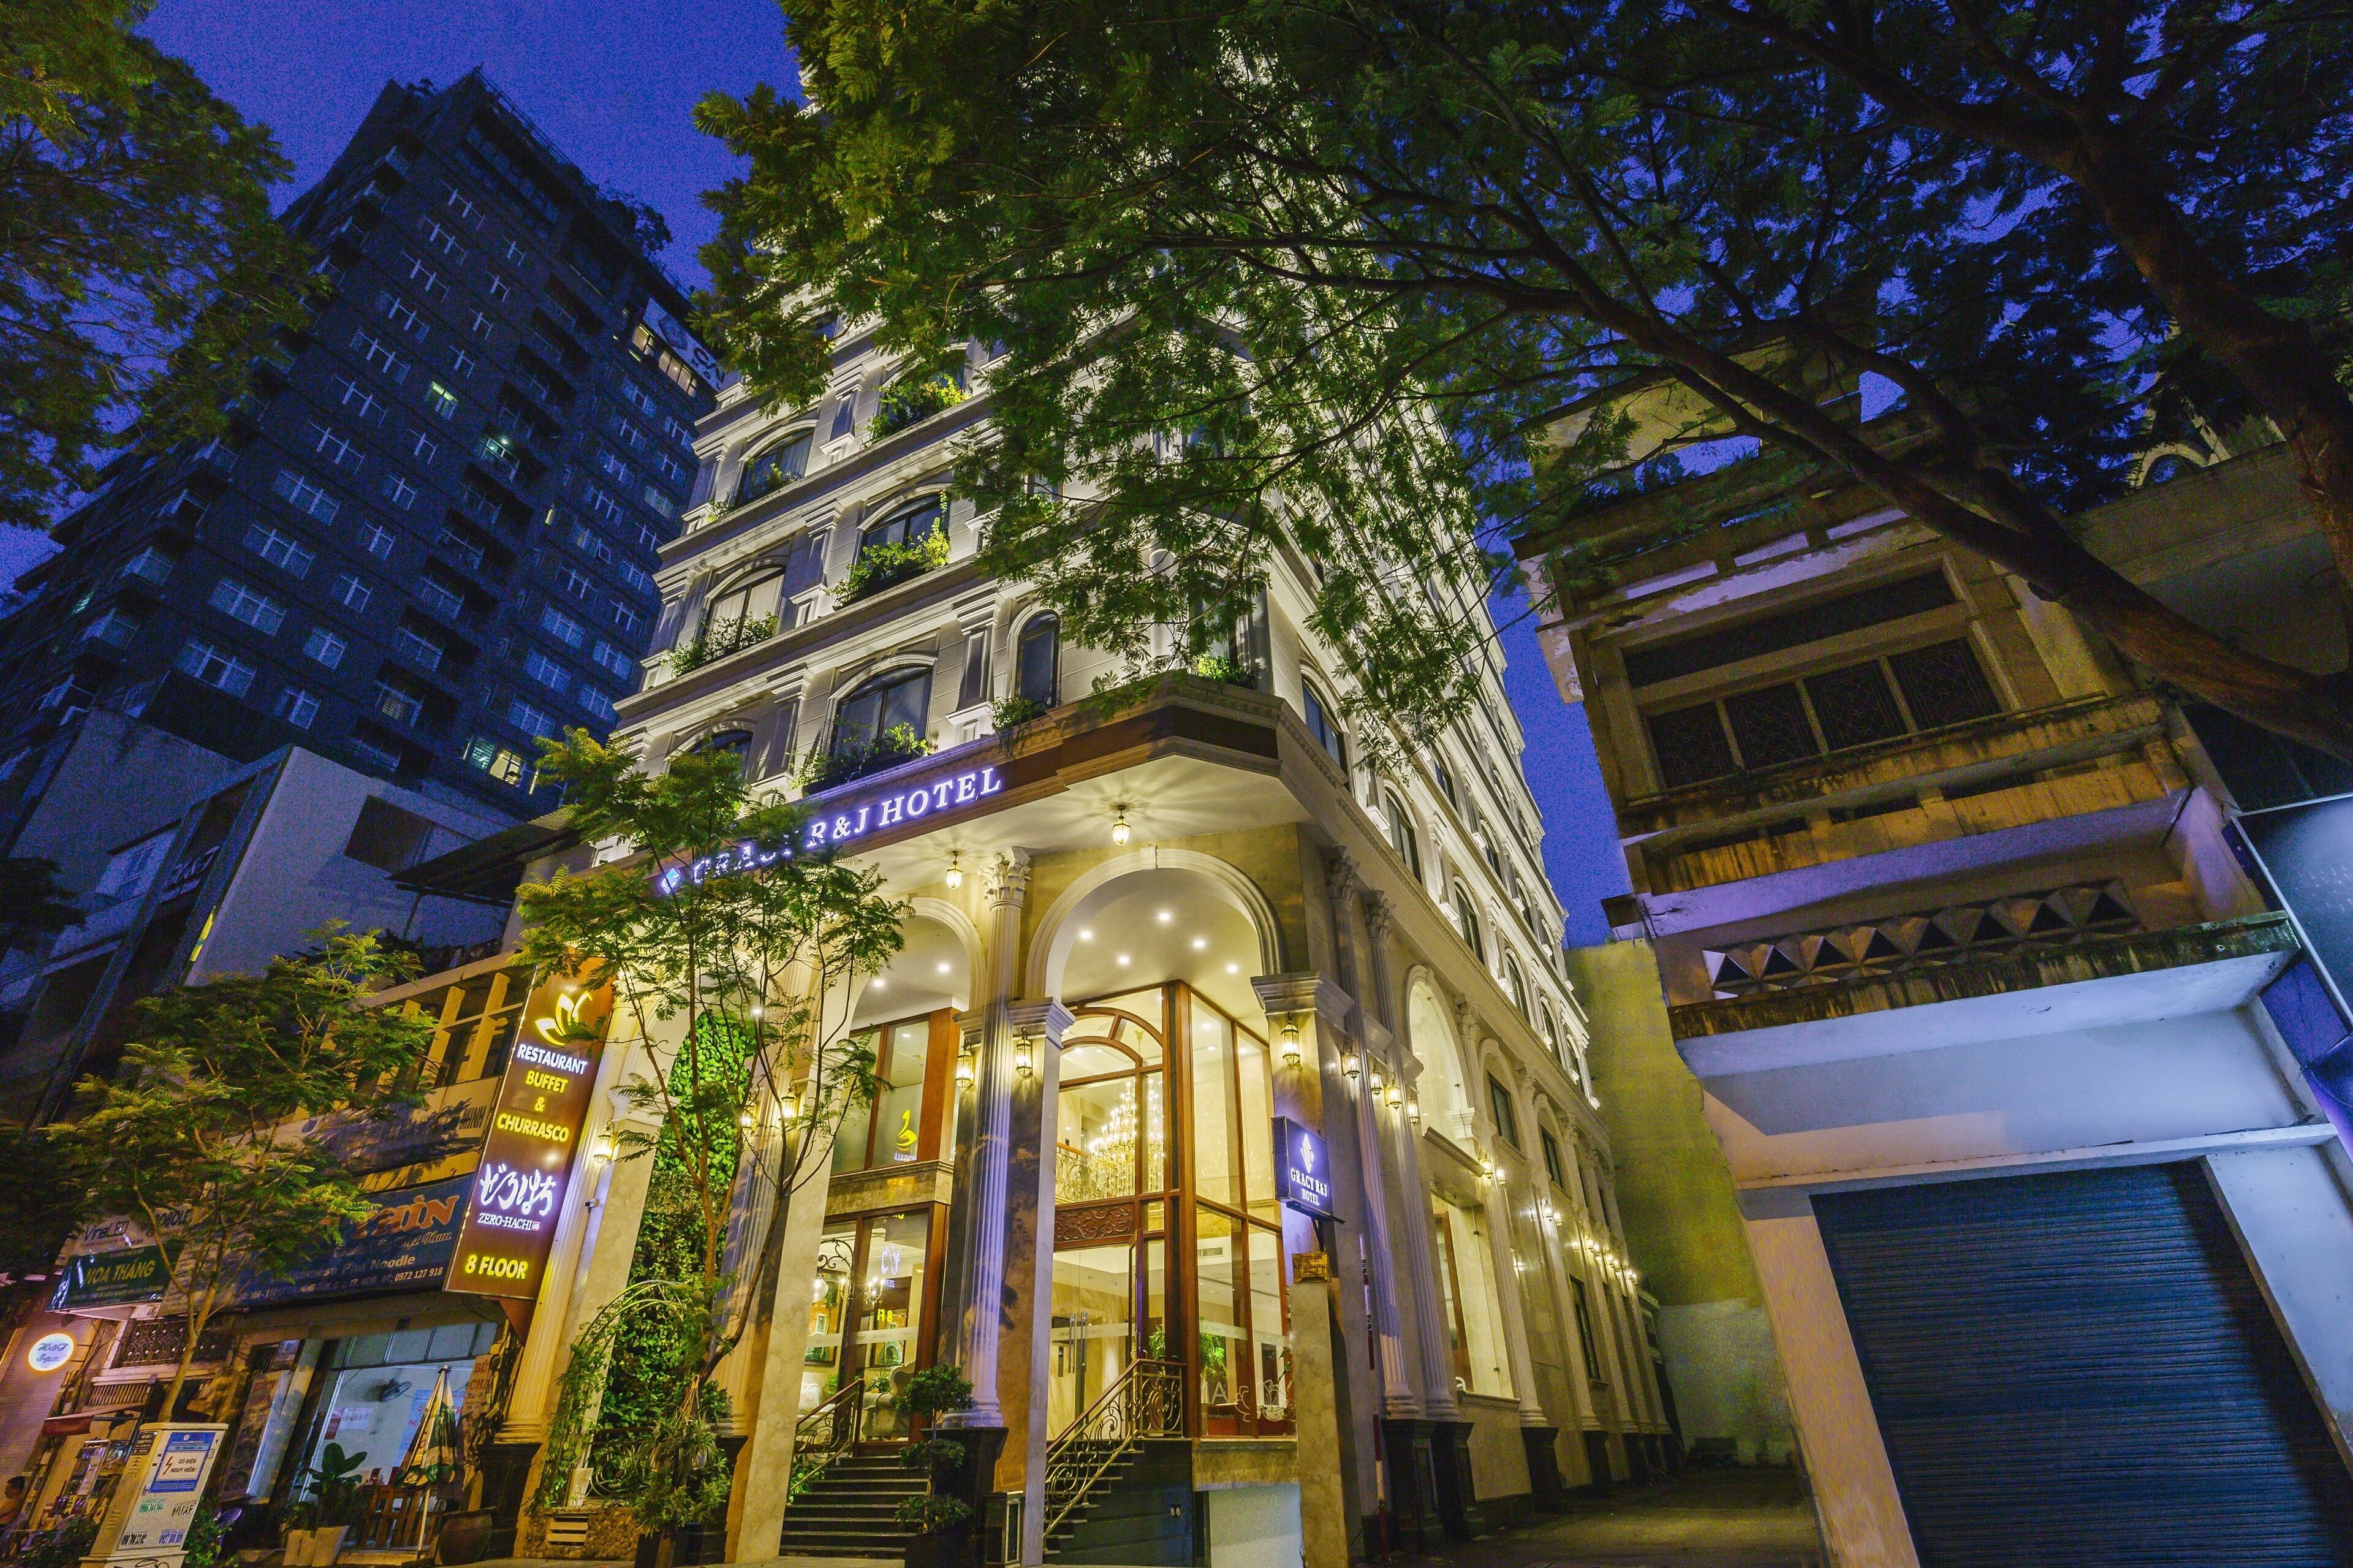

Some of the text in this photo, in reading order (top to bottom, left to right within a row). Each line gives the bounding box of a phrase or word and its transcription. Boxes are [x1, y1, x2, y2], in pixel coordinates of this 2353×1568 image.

[878, 768, 1002, 827] HOTEL
[517, 1044, 588, 1075] RESTAURANT
[525, 1070, 569, 1093] BUFFET
[534, 1097, 545, 1112] &
[497, 1113, 570, 1142] CHURRASCO
[1290, 1168, 1314, 1191] GRACY
[1302, 1188, 1320, 1206] HOTEL
[477, 1212, 533, 1231] ZERO-HACHI
[370, 1254, 417, 1271] Noodle
[464, 1254, 529, 1280] 8 FLOOR
[394, 1271, 414, 1282] 0972
[414, 1269, 428, 1280] 127
[428, 1267, 443, 1278] 918
